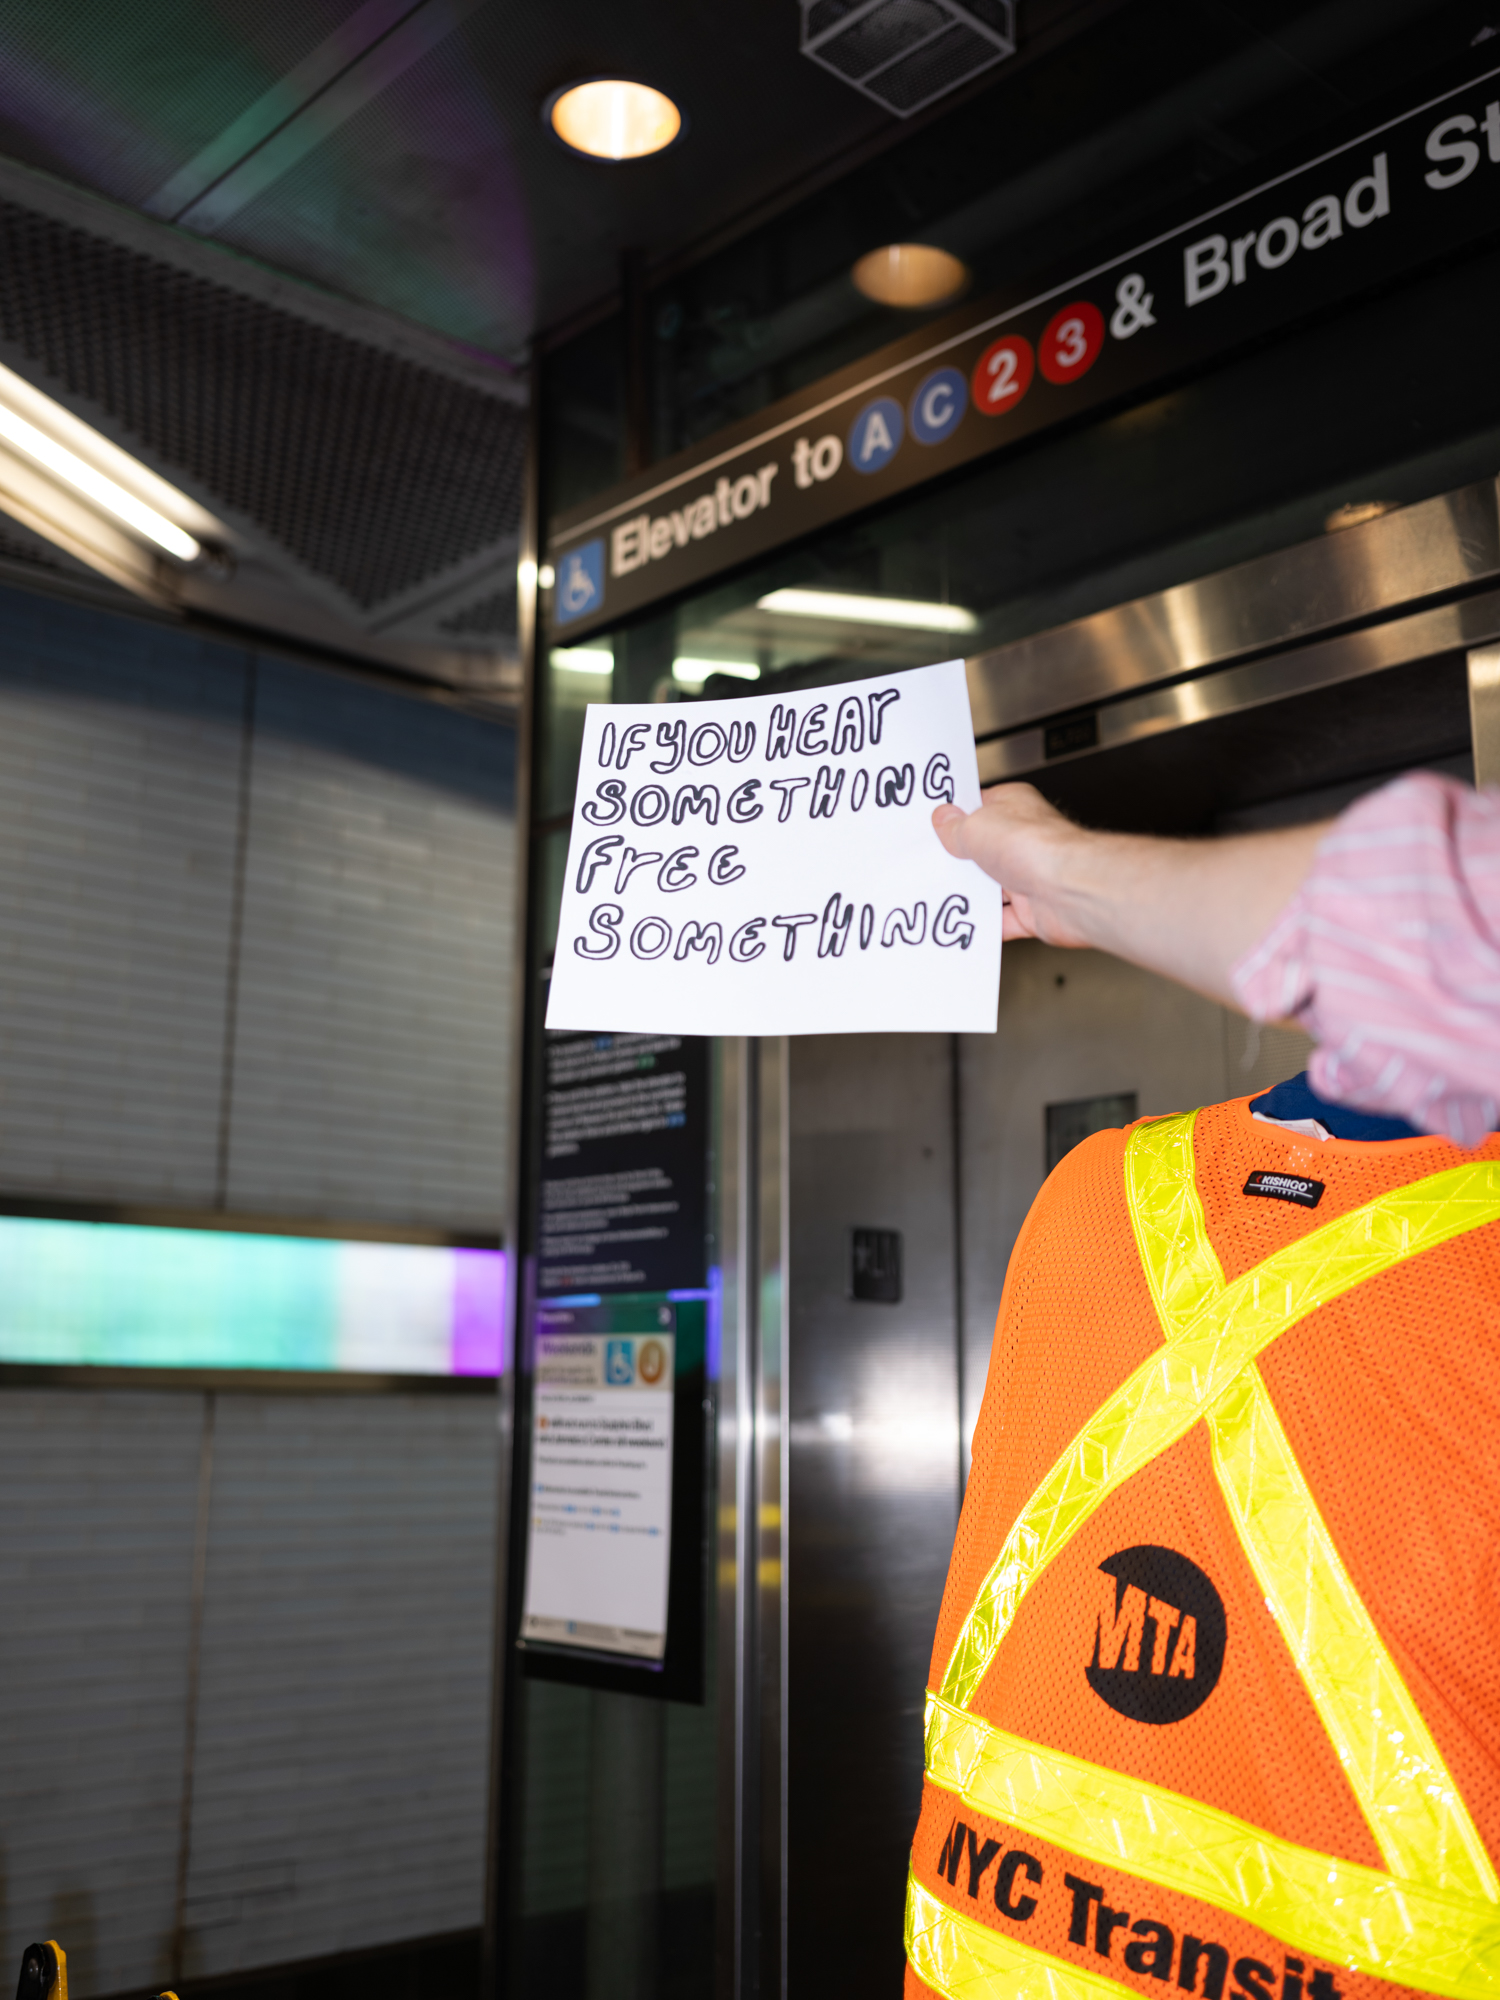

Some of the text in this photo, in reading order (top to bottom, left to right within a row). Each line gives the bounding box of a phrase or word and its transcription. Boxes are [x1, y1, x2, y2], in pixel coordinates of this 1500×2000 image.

[612, 464, 778, 577] Elevator
[792, 436, 843, 489] to
[860, 411, 893, 462] A
[921, 383, 955, 429] C
[987, 347, 1020, 404] 2
[1055, 317, 1088, 368] 3
[1109, 272, 1158, 340] &
[1183, 151, 1391, 308] Broad
[581, 752, 955, 827] SOMETHING
[573, 892, 975, 965] SOMETHING
[1261, 1175, 1308, 1192] KISHIGO
[1094, 1571, 1197, 1680] MTA
[937, 1816, 1043, 1922] NYC
